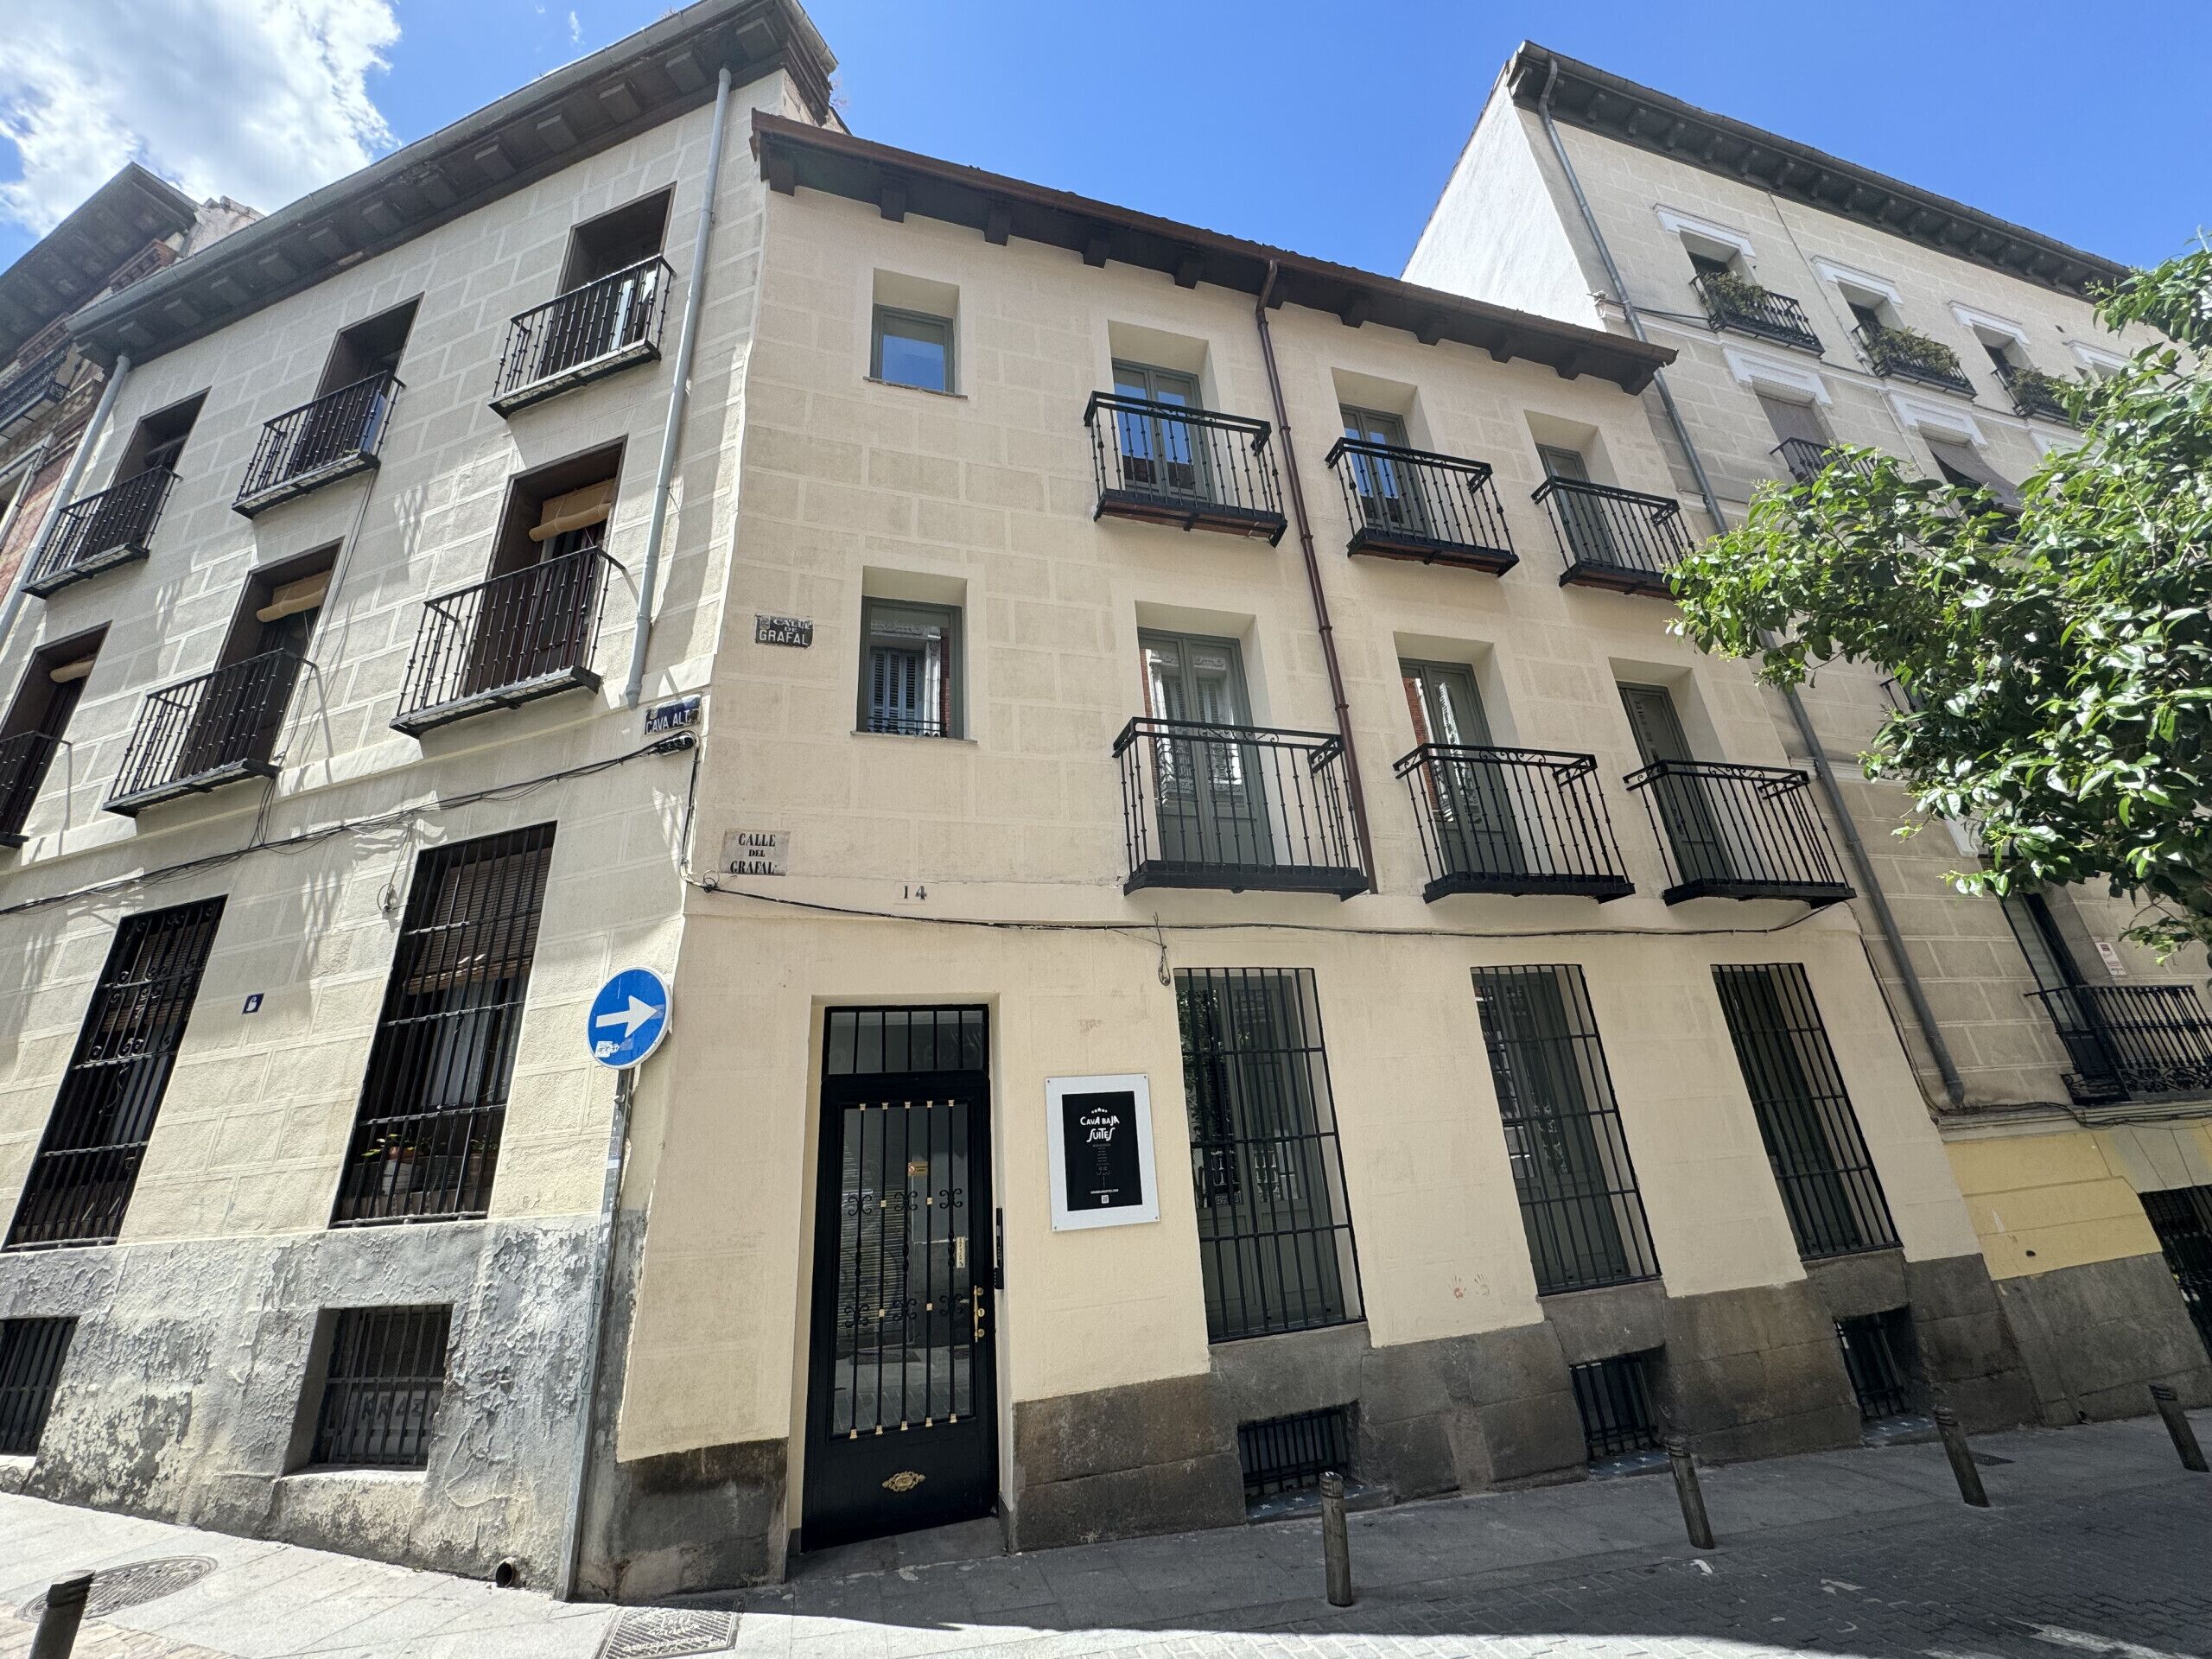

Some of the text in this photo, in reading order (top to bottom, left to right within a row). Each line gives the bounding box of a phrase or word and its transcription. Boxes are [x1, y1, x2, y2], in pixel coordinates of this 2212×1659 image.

[773, 619, 812, 629] CALLE
[760, 630, 809, 645] GRAFAL
[646, 715, 669, 734] CAVA
[738, 833, 776, 847] CALLE
[904, 885, 927, 900] 14
[1080, 1116, 1120, 1126] CAVA BAJA
[1086, 1127, 1116, 1142] SUITES
